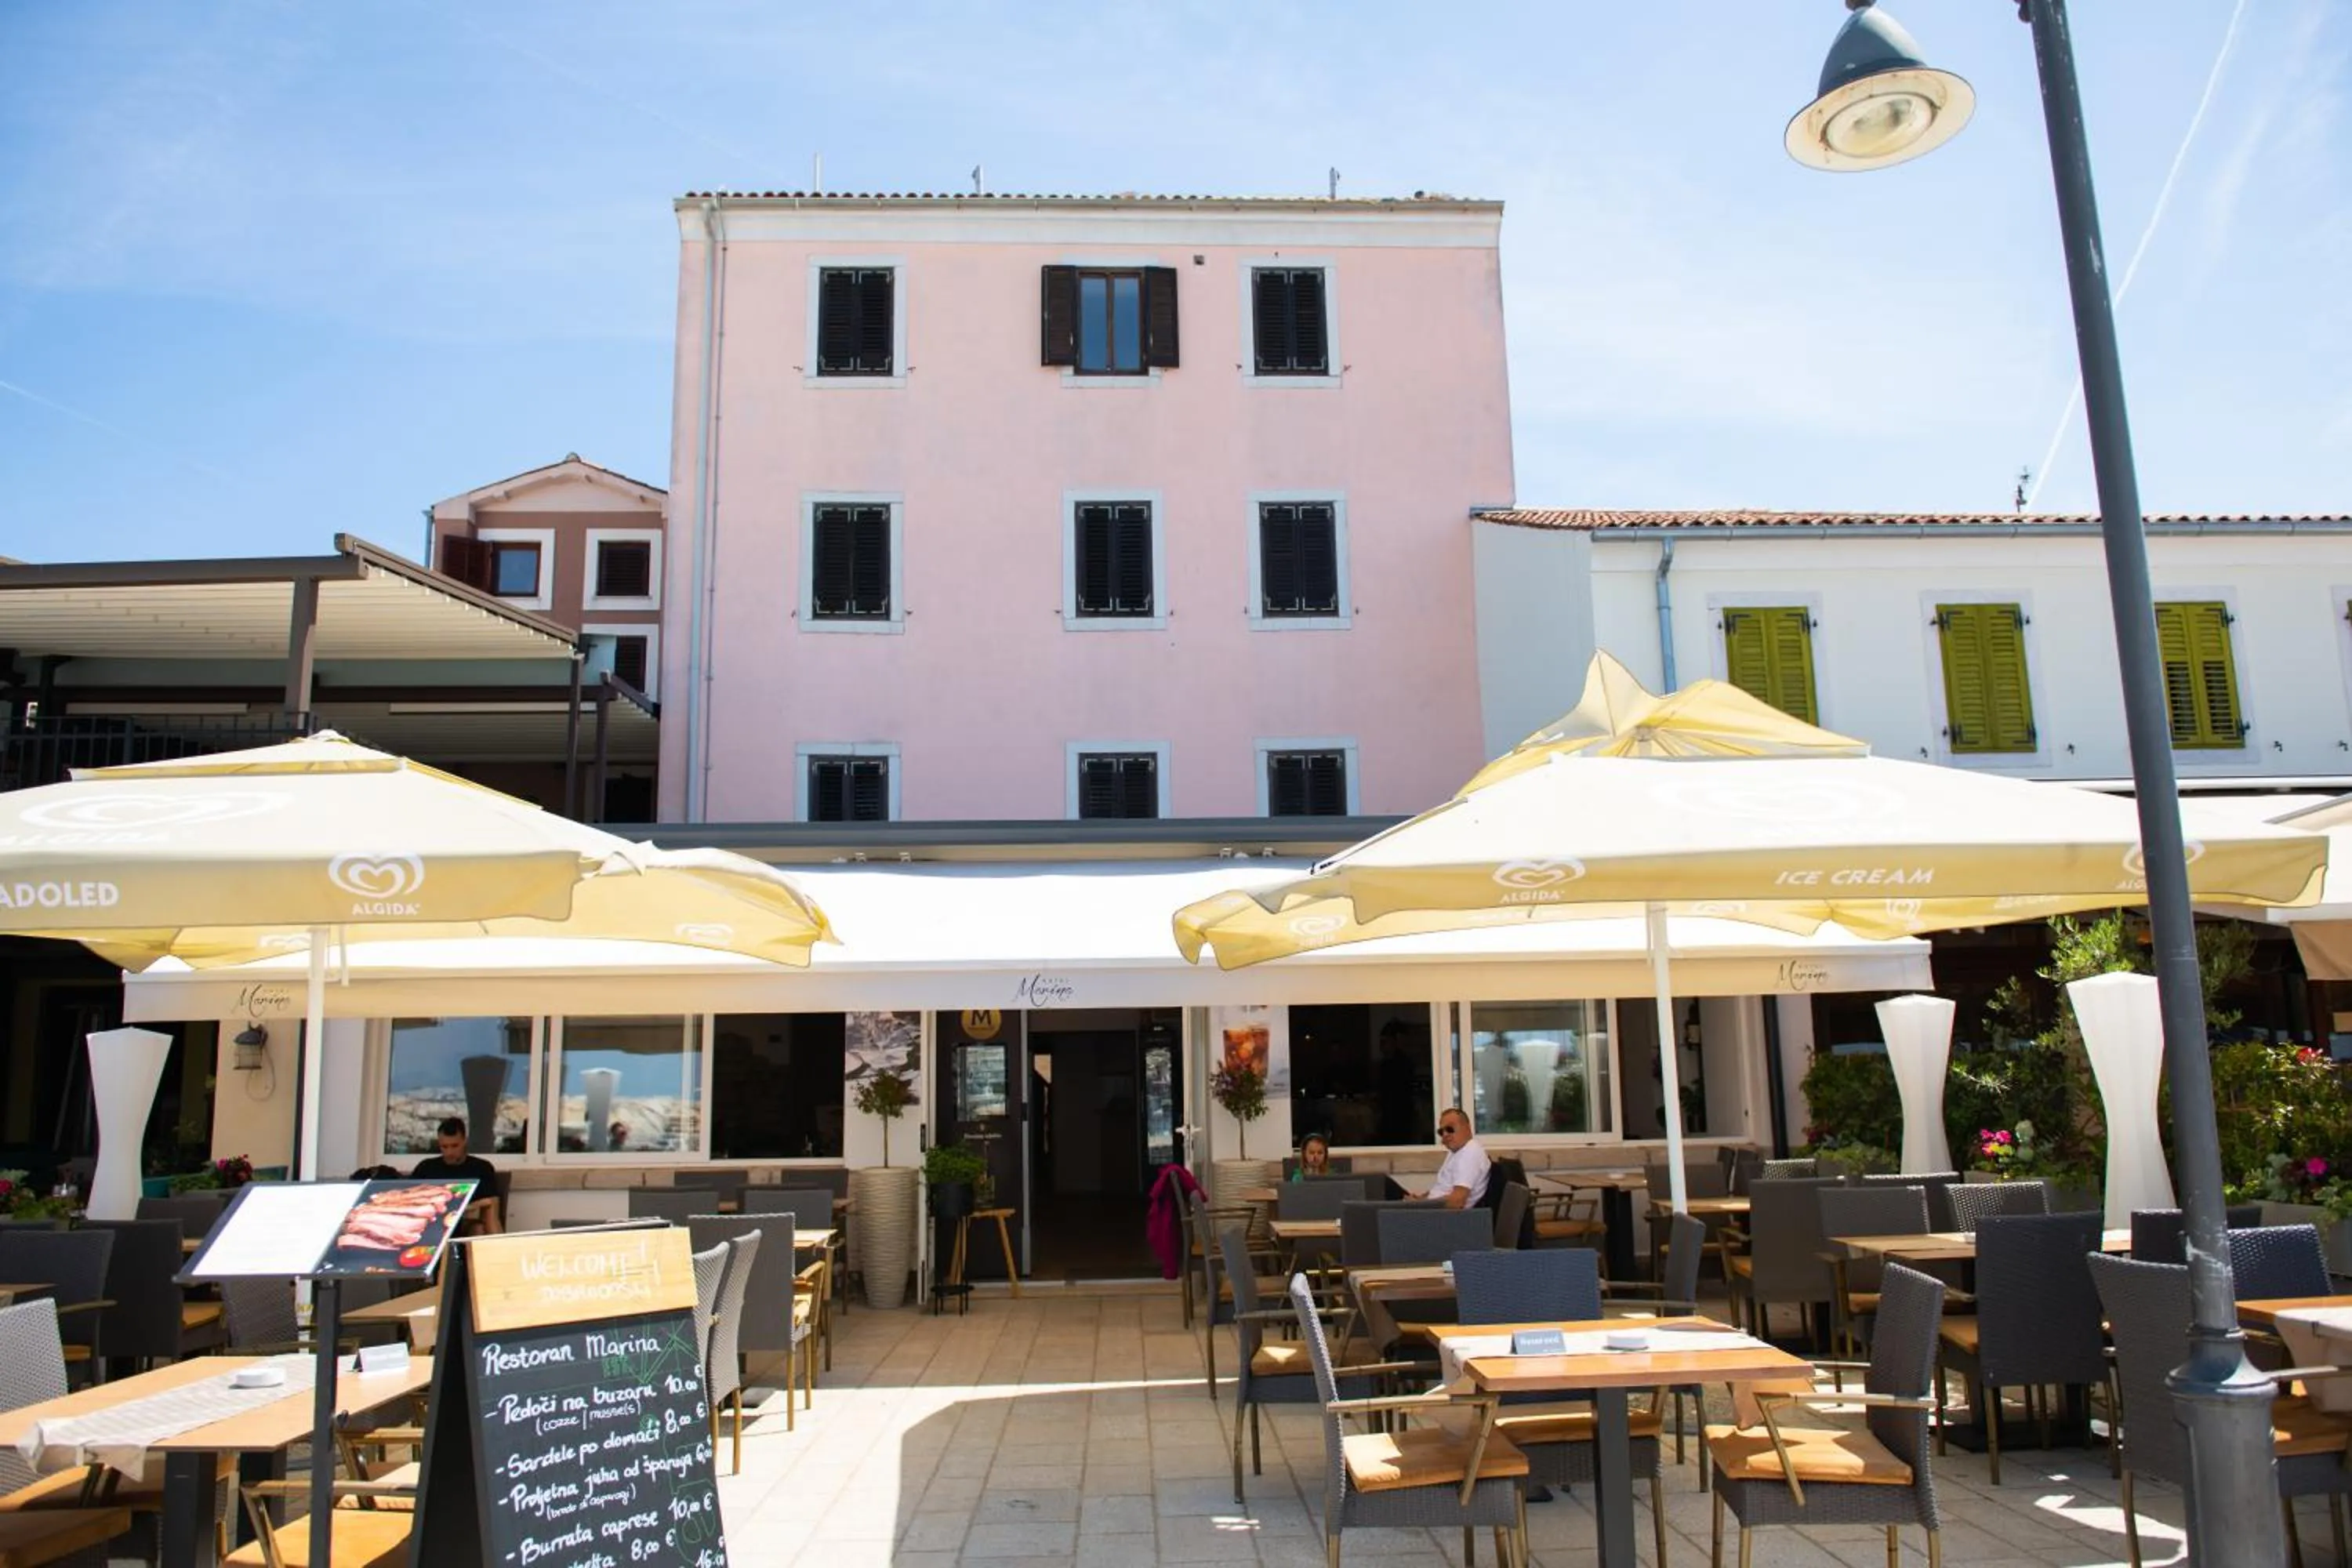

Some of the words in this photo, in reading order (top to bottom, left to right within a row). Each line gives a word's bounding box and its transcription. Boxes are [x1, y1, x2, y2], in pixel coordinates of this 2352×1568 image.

[1775, 869, 1824, 884] ICE
[1830, 867, 1935, 884] CREAM
[352, 902, 416, 916] ALGIDA
[1500, 890, 1561, 903] ALGIDA
[482, 1342, 575, 1376] Restoran
[586, 1334, 661, 1359] Marina
[563, 1396, 588, 1410] na
[593, 1385, 657, 1406] buzaru
[508, 1445, 576, 1479] Sardele
[579, 1444, 599, 1466] po
[584, 1467, 619, 1497] juha
[623, 1459, 640, 1478] od
[521, 1523, 594, 1566] Burrata
[601, 1511, 659, 1542] caprese
